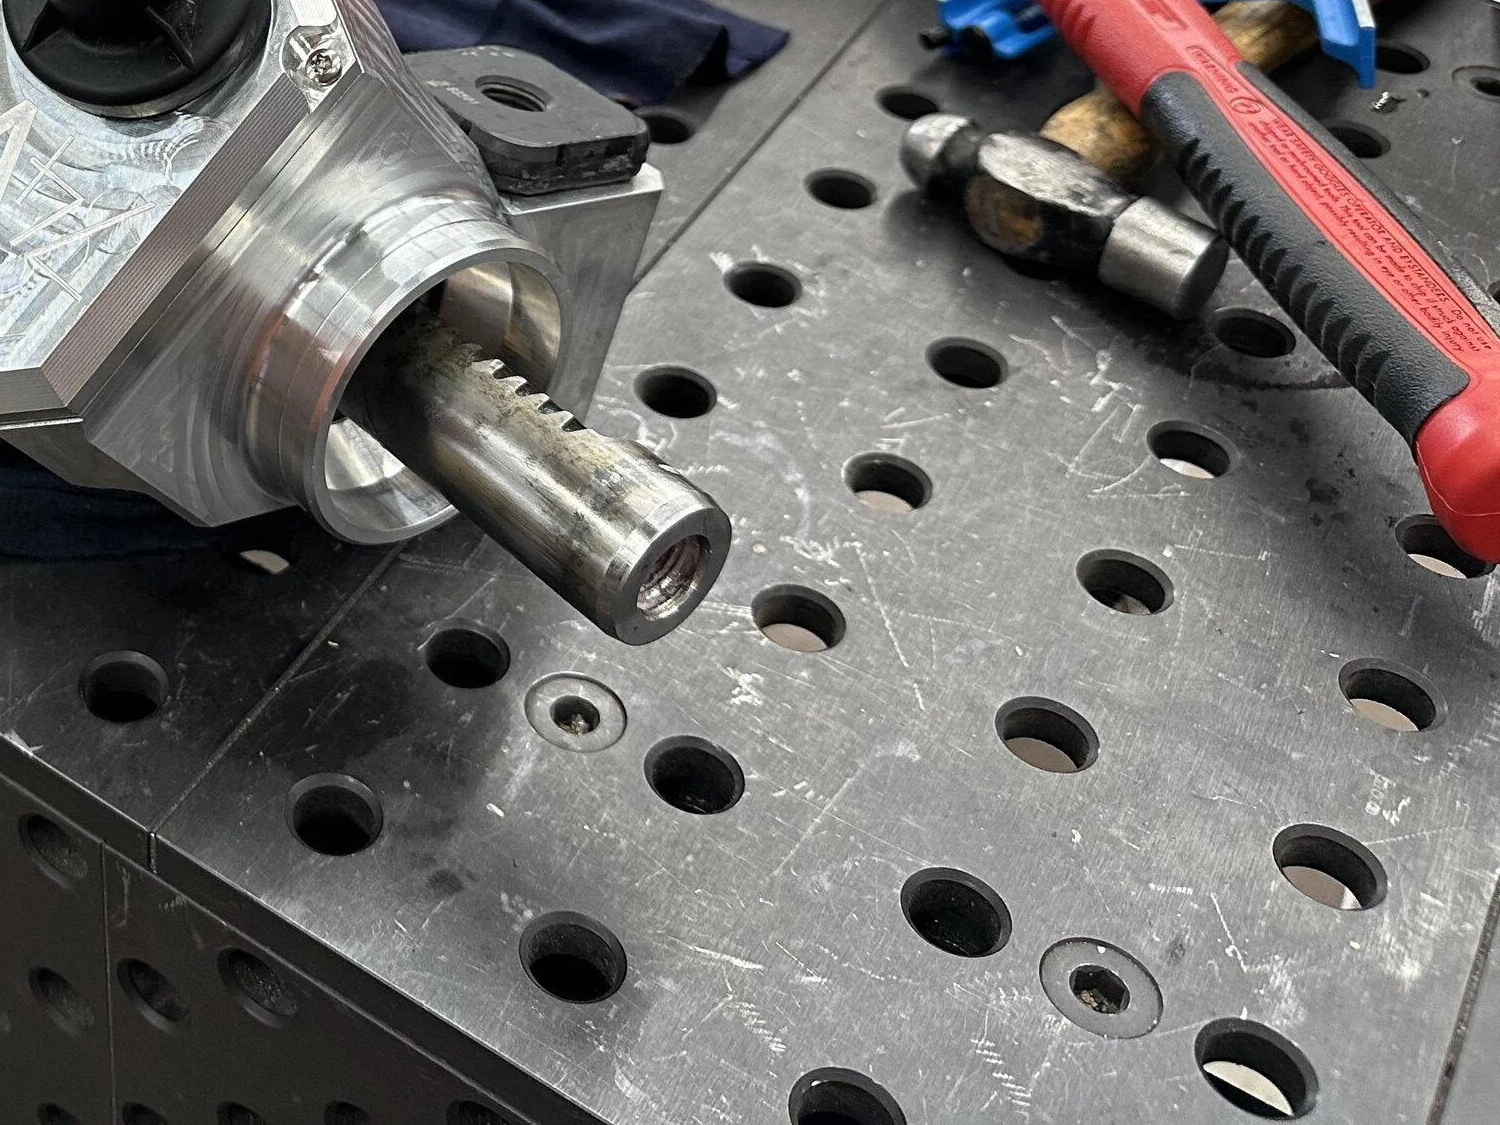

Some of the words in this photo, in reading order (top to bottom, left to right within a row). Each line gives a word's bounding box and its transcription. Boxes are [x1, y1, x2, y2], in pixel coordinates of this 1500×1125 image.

[1345, 198, 1385, 235] OPERATOR
[1381, 235, 1403, 253] AND
[1462, 321, 1479, 335] not
[1476, 336, 1492, 350] use
[1384, 253, 1408, 273] made
[1449, 326, 1481, 352] against
[1401, 286, 1427, 306] other
[1417, 306, 1447, 329] bodily
